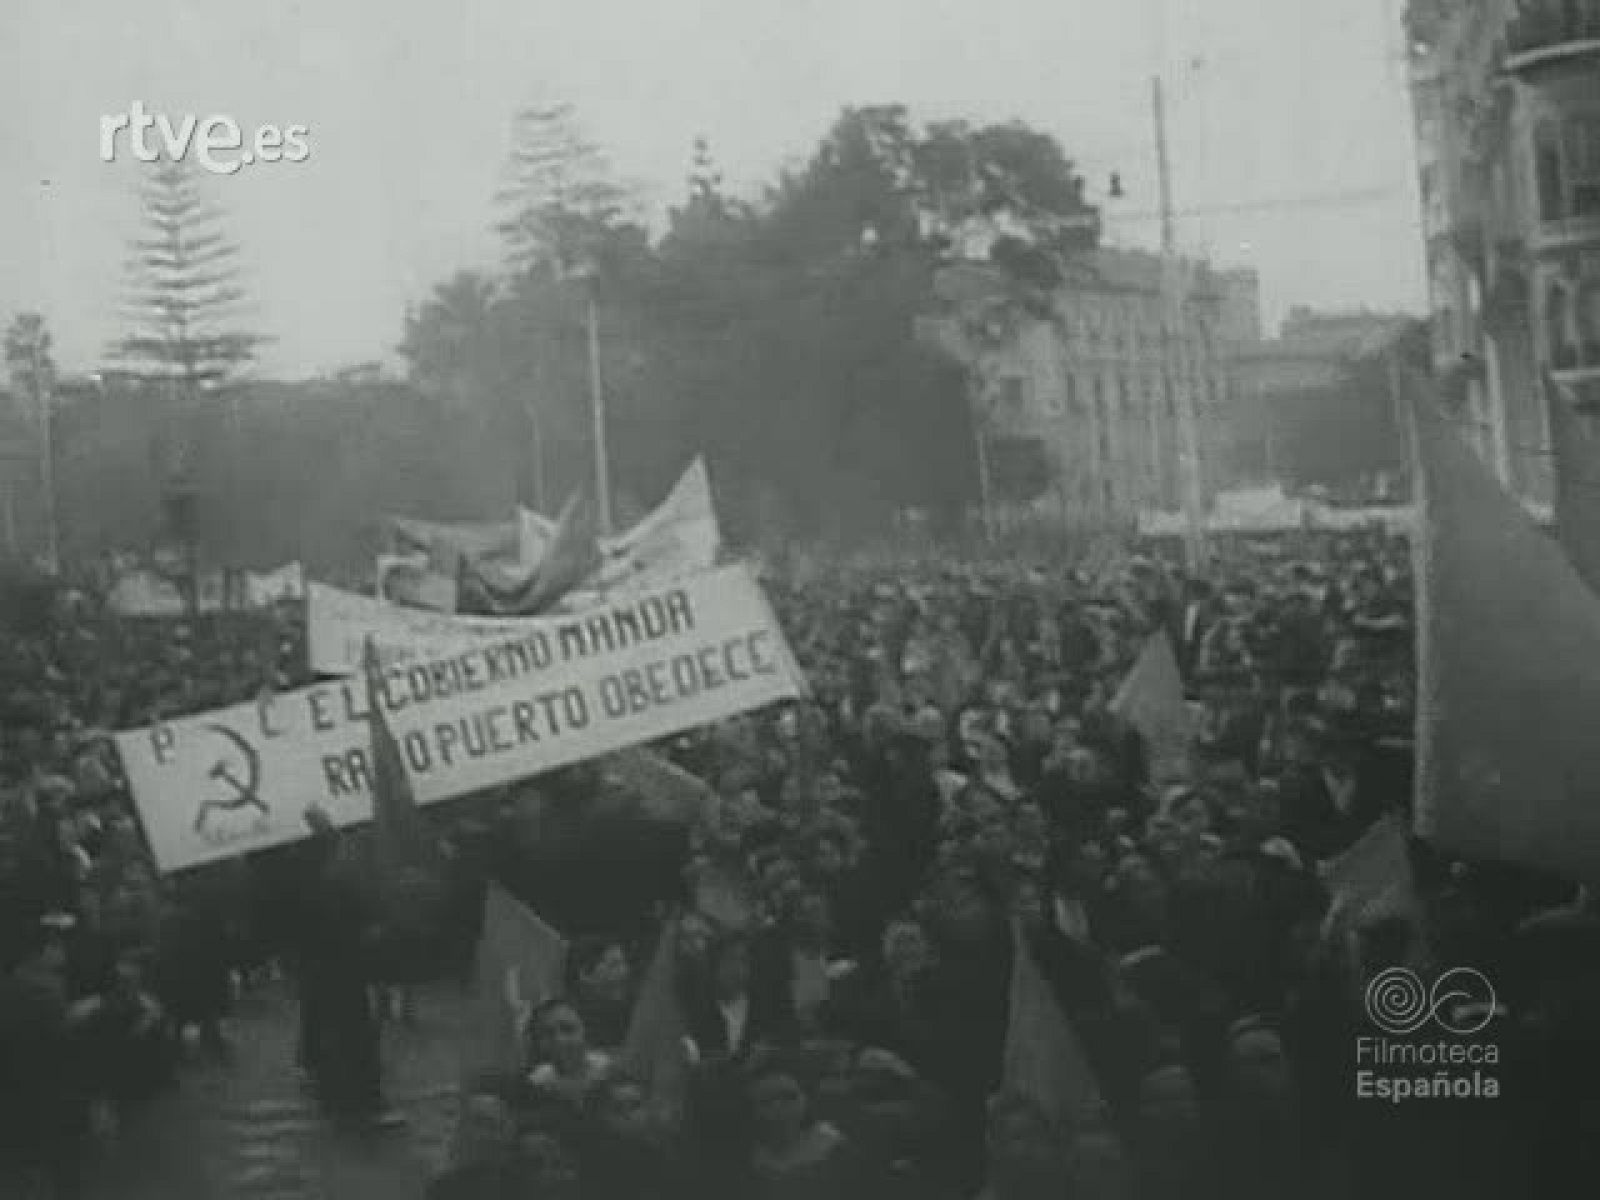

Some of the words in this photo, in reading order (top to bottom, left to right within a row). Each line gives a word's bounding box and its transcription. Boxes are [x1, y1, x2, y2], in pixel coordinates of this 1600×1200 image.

[307, 680, 375, 731] EL
[558, 588, 696, 661] MANDA
[434, 684, 589, 768] PUERTO
[602, 628, 777, 720] OBEDECE
